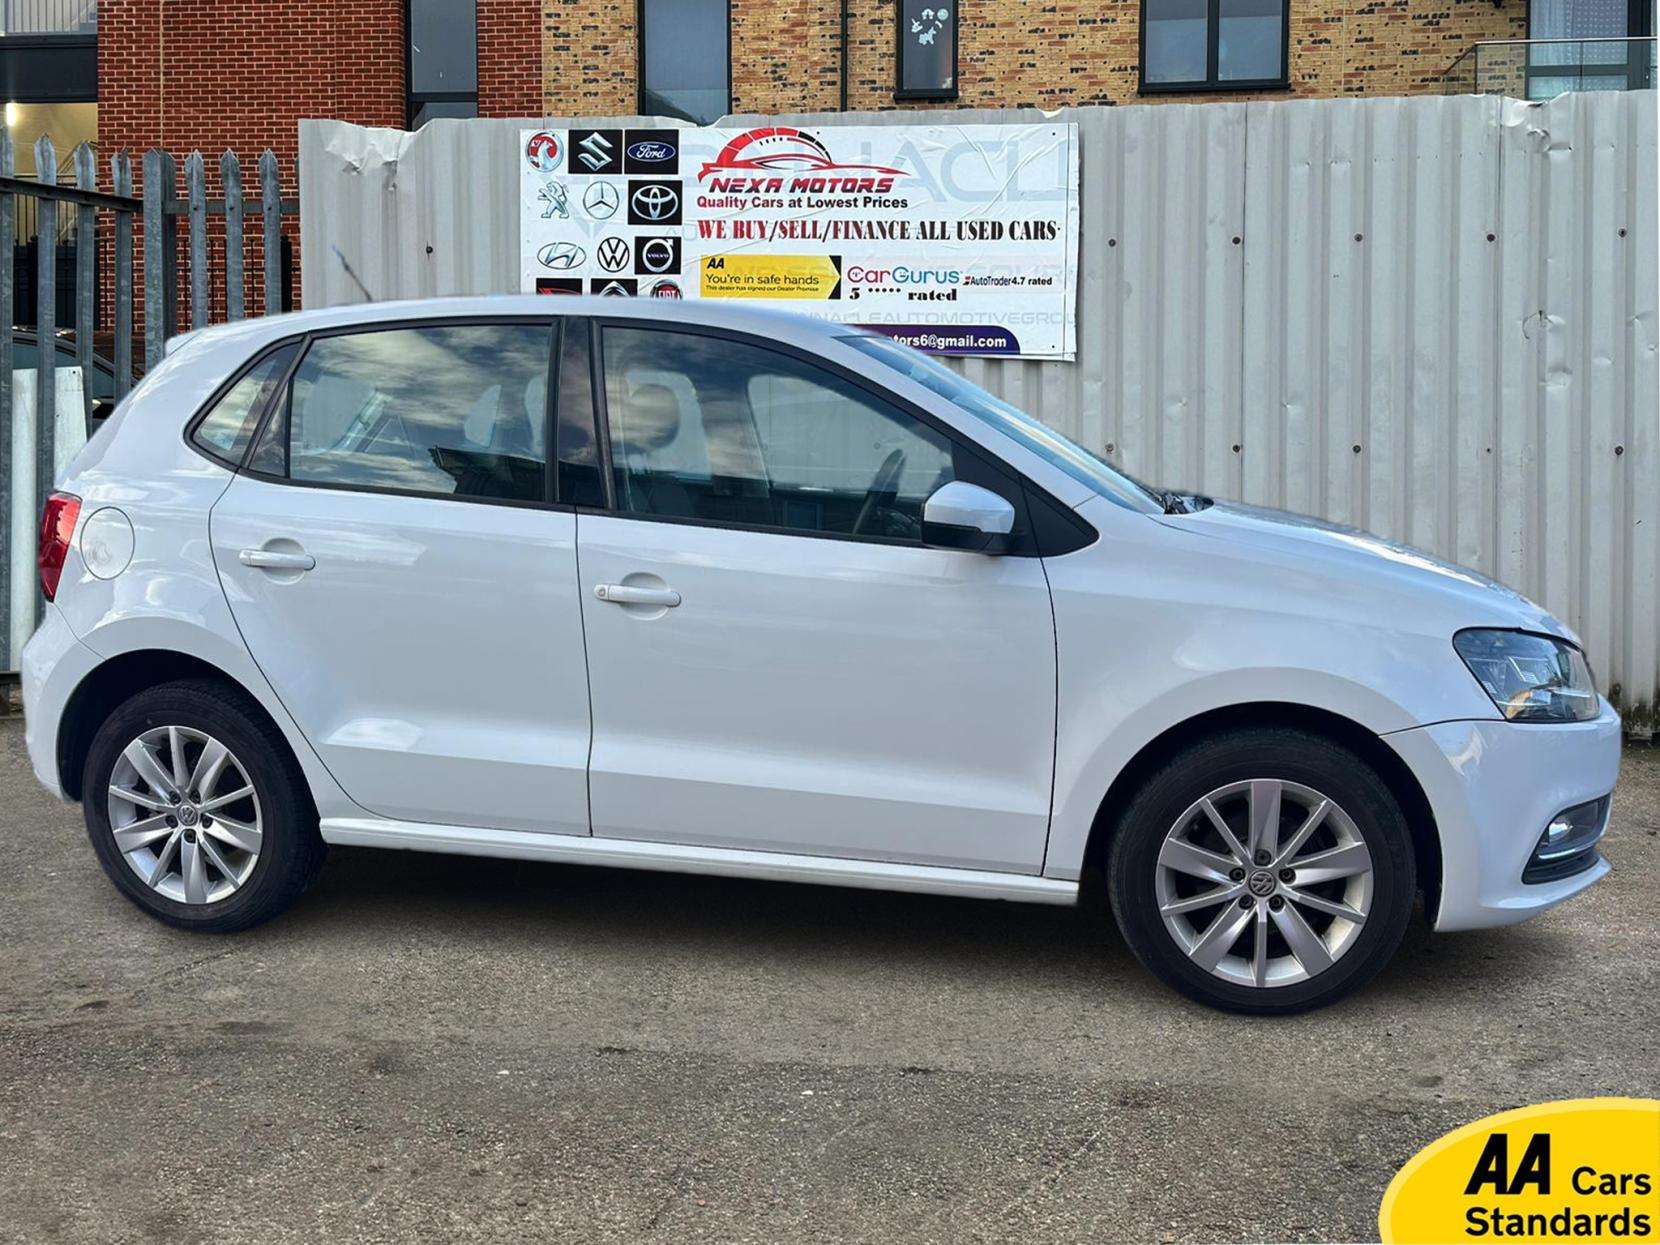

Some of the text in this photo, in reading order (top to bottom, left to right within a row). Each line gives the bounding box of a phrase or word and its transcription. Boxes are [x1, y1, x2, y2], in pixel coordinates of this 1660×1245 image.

[636, 144, 666, 158] Ford
[709, 177, 895, 193] NEXA MOTORS
[697, 196, 909, 210] Quality Cars at Lowest Prices
[697, 219, 727, 239] WE
[916, 220, 951, 240] ALL
[957, 220, 1004, 240] USED
[1008, 220, 1057, 240] CARS
[706, 257, 725, 269] AA
[706, 273, 820, 285] You're in safe hands
[847, 266, 960, 283] CarGurus
[1028, 276, 1053, 286] rated
[849, 287, 958, 301] 5 rated
